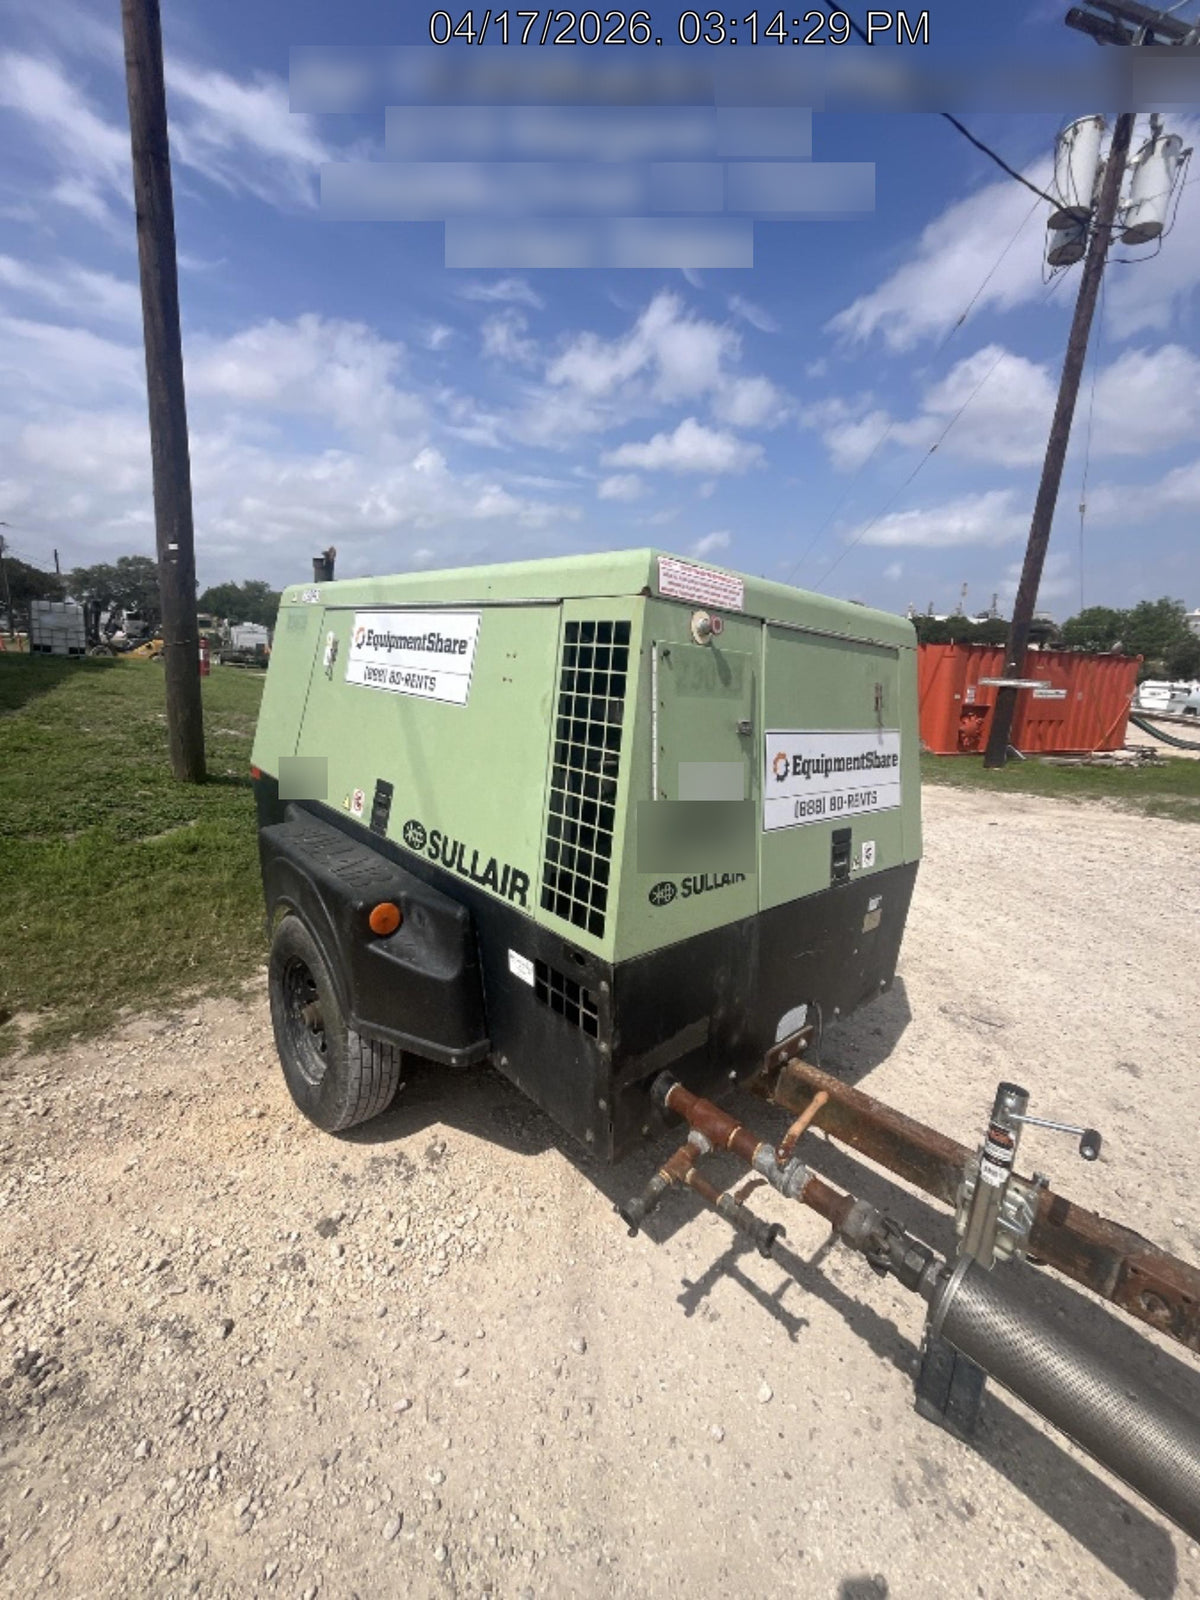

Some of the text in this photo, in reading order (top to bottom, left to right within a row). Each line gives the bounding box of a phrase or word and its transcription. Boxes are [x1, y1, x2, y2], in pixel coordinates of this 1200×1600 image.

[365, 628, 468, 655] EquipmentShare
[792, 750, 898, 780] EquipmentShare
[428, 829, 530, 907] SULLAIR
